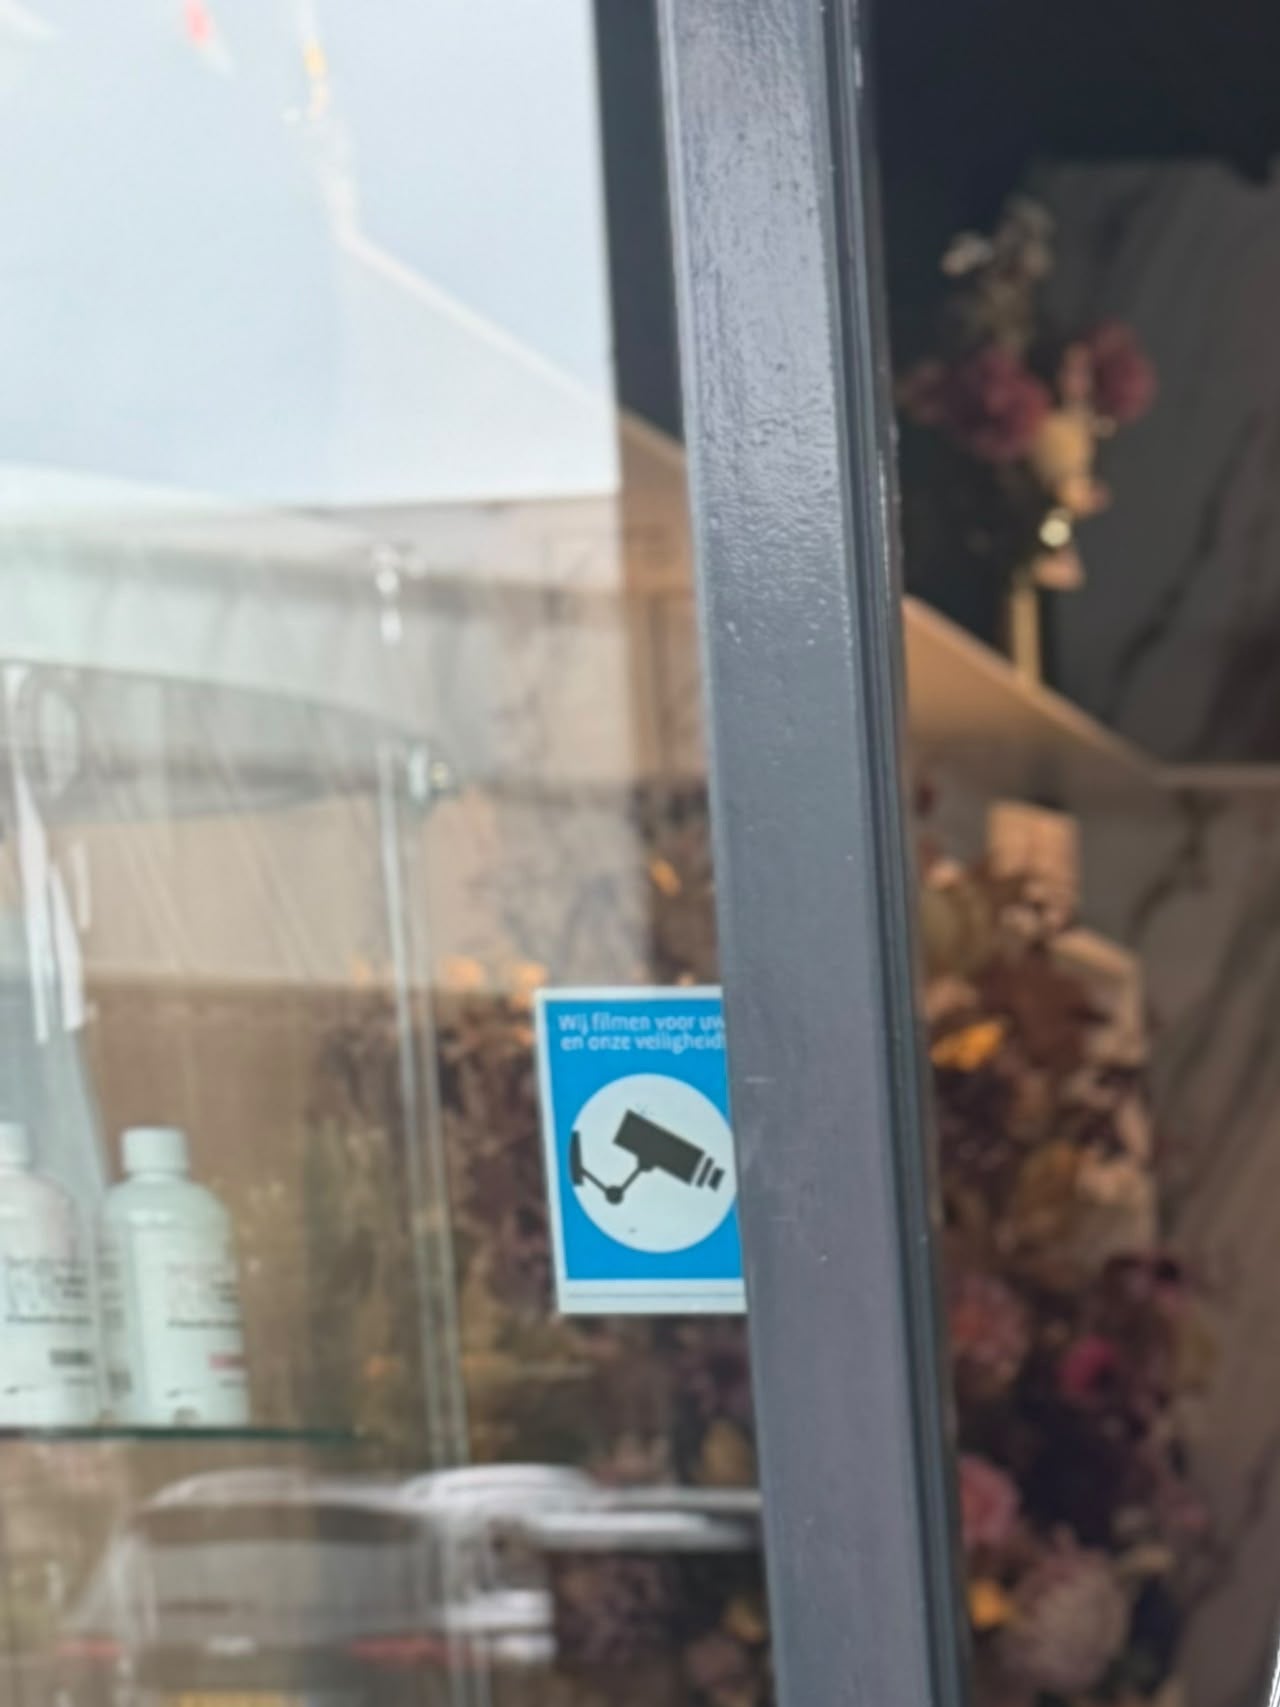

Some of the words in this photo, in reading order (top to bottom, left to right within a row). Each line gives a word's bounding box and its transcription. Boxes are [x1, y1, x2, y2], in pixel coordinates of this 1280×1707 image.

[558, 1013, 588, 1036] Wij
[591, 1012, 651, 1031] filmen
[655, 1016, 695, 1031] voor
[560, 1035, 584, 1051] en
[587, 1035, 631, 1051] onze
